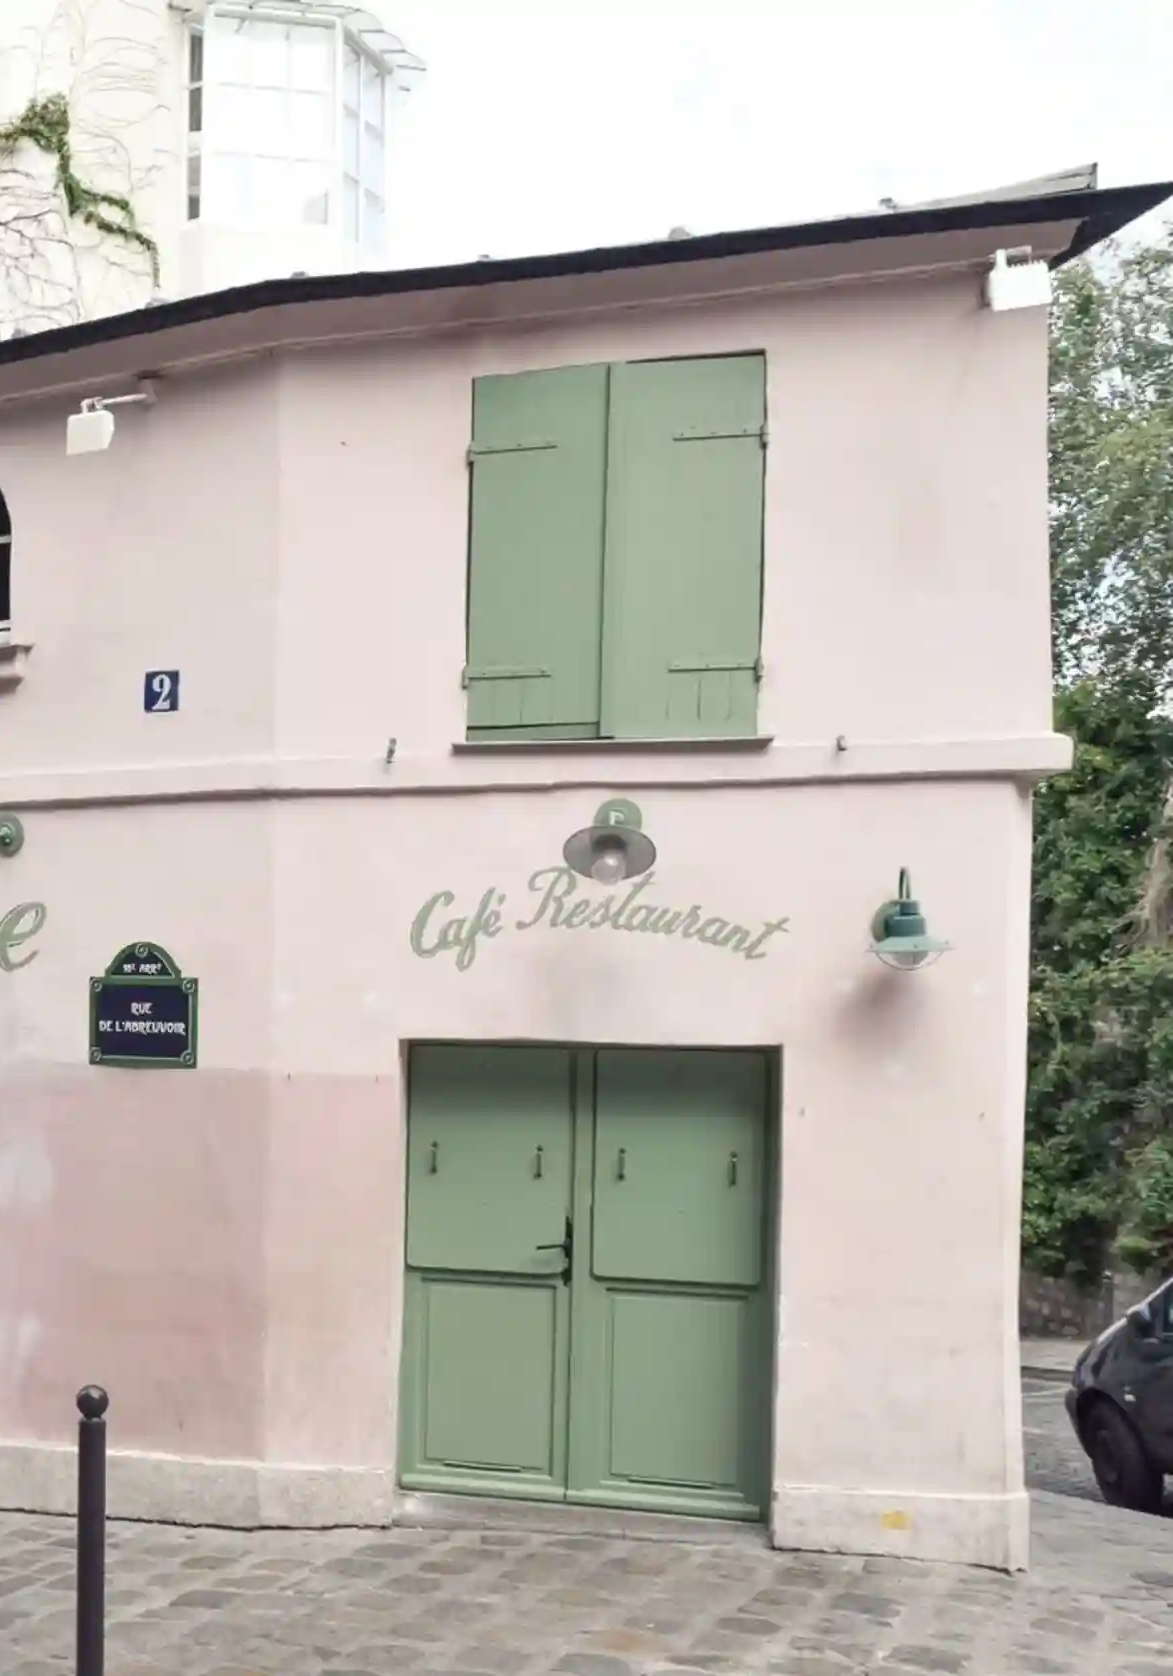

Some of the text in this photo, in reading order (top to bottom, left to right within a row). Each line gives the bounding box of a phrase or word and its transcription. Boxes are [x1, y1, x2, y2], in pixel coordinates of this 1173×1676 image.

[152, 674, 171, 710] 2
[410, 866, 790, 972] Café Restaurant
[130, 1002, 153, 1016] RUE
[98, 1020, 186, 1036] DE L'ABREUVOIR
